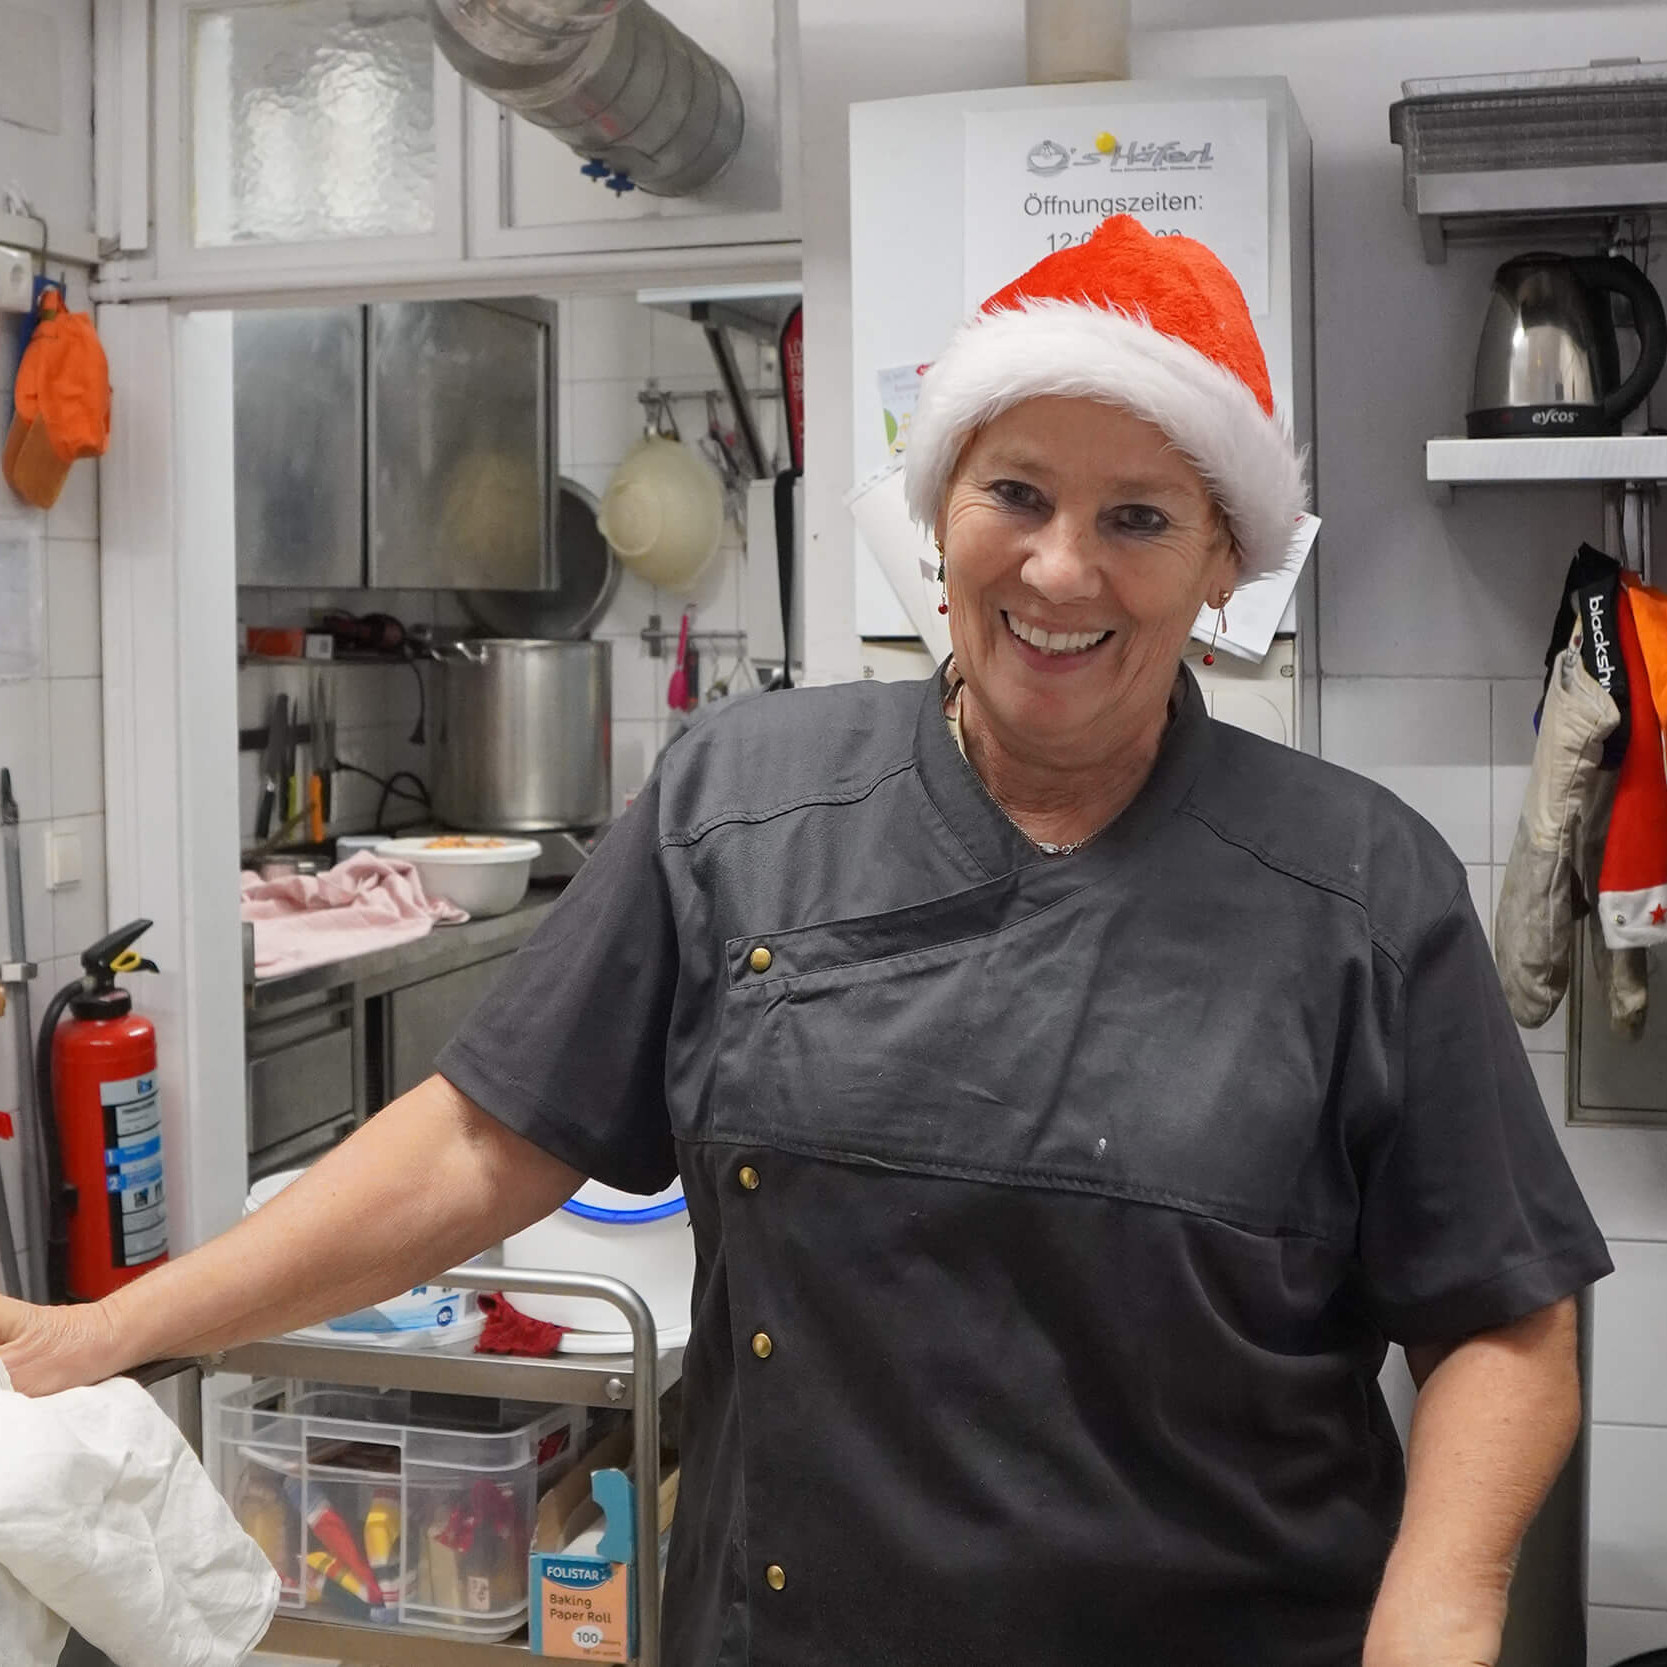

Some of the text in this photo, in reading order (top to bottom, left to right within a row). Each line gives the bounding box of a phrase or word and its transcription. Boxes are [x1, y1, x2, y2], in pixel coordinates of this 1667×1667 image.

[1023, 191, 1203, 217] Öffnungszeiten:
[546, 1566, 600, 1581] FOLISTAR
[549, 1593, 593, 1609] Baking
[549, 1608, 612, 1624] Paper Roll
[576, 1631, 600, 1644] 100
